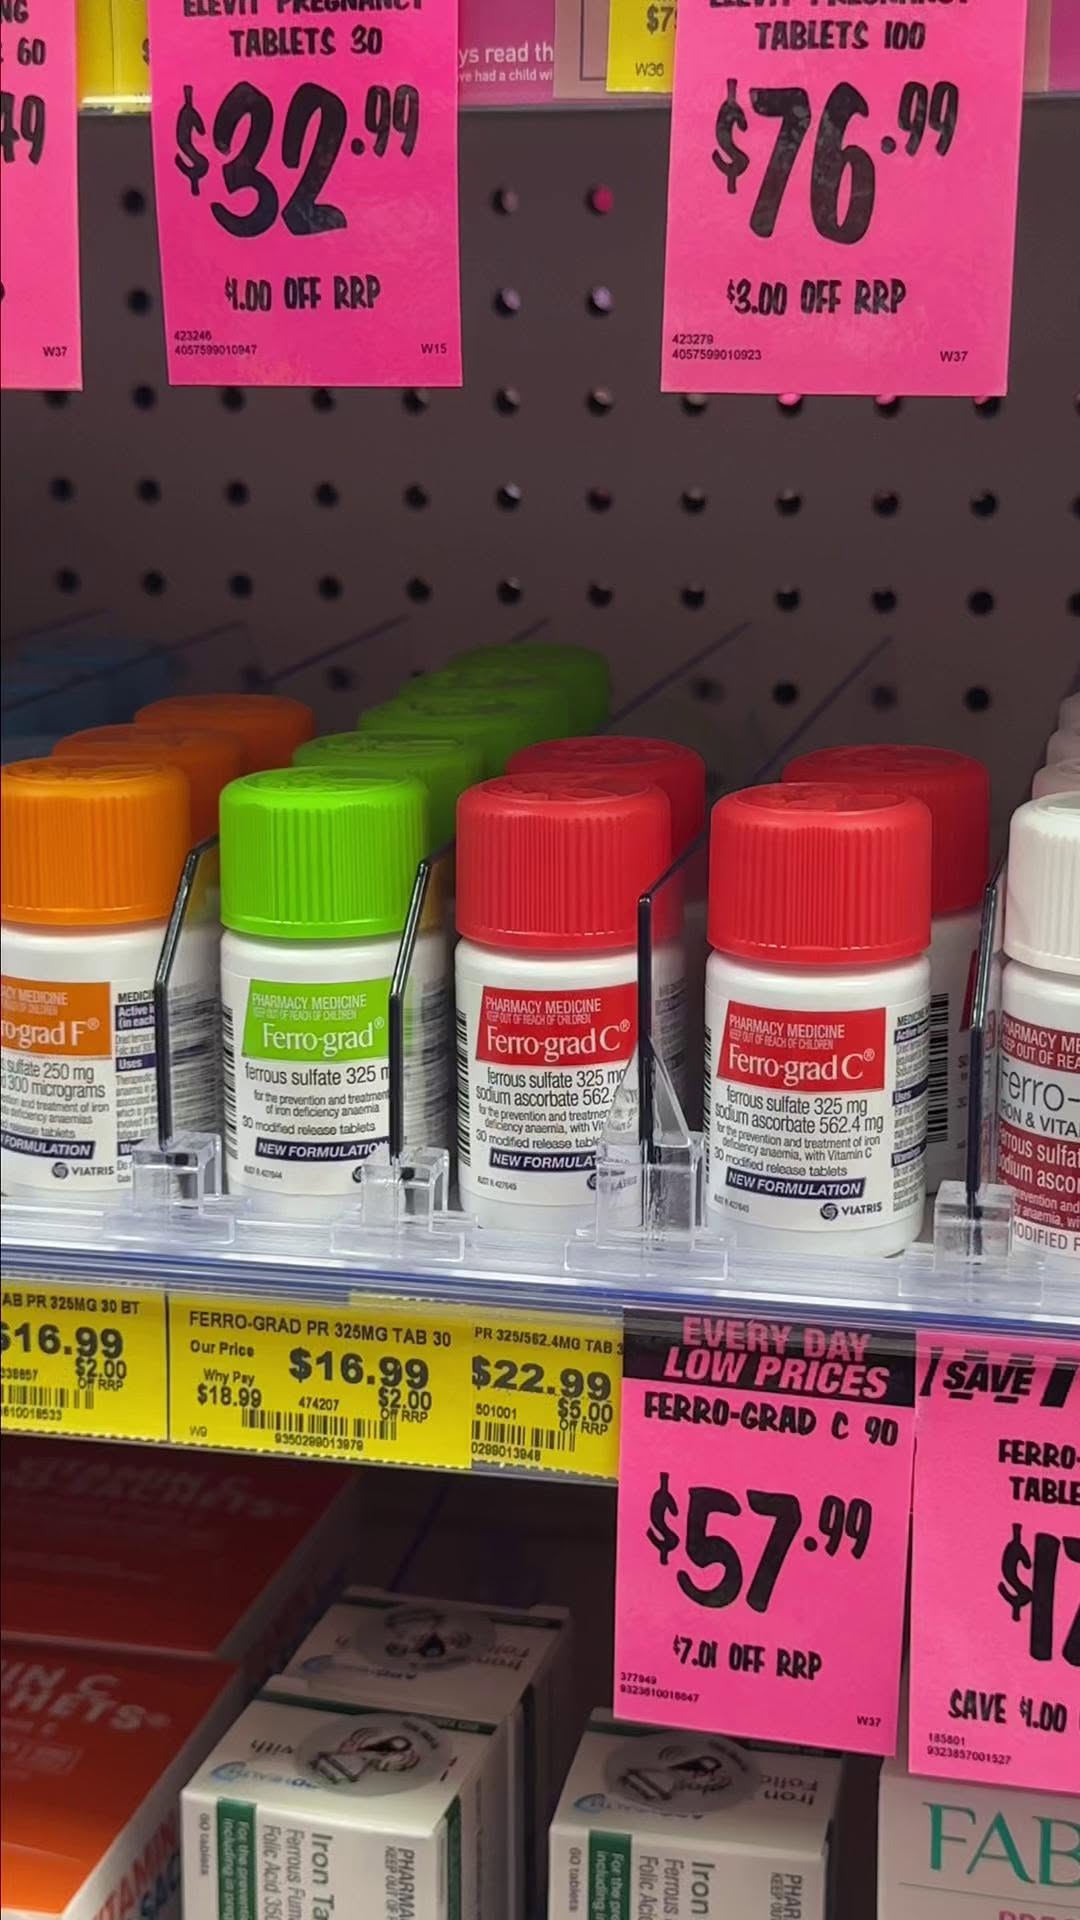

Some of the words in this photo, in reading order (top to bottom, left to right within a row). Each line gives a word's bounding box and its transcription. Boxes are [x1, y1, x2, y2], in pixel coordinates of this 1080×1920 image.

[229, 27, 336, 57] TABLETS
[350, 25, 383, 55] 30
[755, 20, 869, 50] TABLETS
[884, 20, 925, 50] 100
[17, 37, 46, 66] 60
[485, 41, 529, 63] read
[475, 69, 496, 82] had
[499, 73, 506, 81] a
[509, 69, 536, 81] child
[175, 81, 420, 238] $32.99
[712, 77, 960, 245] $76.99
[225, 276, 272, 311] $1.00
[284, 276, 321, 310] OFF
[333, 275, 381, 310] RRP
[726, 279, 787, 316] $3.00
[801, 280, 842, 315] OFF
[854, 279, 906, 315] RRP
[174, 330, 212, 341] 423246
[672, 334, 714, 345] 423279
[43, 346, 68, 357] W37
[421, 344, 447, 355] W15
[672, 348, 762, 361] 4057599010923
[940, 351, 968, 362] W37
[252, 993, 308, 1009] PHARMACY
[312, 993, 368, 1010] MEDICINE
[485, 995, 541, 1013] PHARMACY
[545, 998, 601, 1013] MEDICINE
[730, 1015, 784, 1037] PHARMACY
[787, 1024, 845, 1039] MEDICINE
[487, 1025, 596, 1063] Ferro-grad
[799, 1038, 833, 1050] CHILDREN
[1017, 1042, 1036, 1060] OUT
[1040, 1049, 1054, 1064] OF
[43, 1062, 69, 1080] 250
[73, 1067, 94, 1084] mg
[118, 1058, 143, 1070] Uses
[245, 1062, 288, 1085] ferrous
[291, 1067, 341, 1086] sulfate
[346, 1066, 376, 1085] 325
[729, 1044, 837, 1087] Ferro-grad
[487, 1067, 526, 1088] ferrous
[529, 1069, 573, 1089] sulfate
[576, 1070, 603, 1087] 325
[31, 1079, 106, 1101] micrograms
[280, 1093, 326, 1106] prevention
[328, 1094, 346, 1105] and
[476, 1085, 511, 1106] sodium
[514, 1089, 579, 1107] ascorbate
[726, 1085, 763, 1111] ferrous
[767, 1094, 810, 1115] sulfate
[814, 1098, 842, 1115] 325
[846, 1098, 868, 1117] mg
[36, 1101, 78, 1112] treatment
[81, 1102, 90, 1112] of
[92, 1103, 110, 1112] iron
[275, 1105, 291, 1116] iron
[293, 1105, 339, 1119] deficiency
[341, 1103, 380, 1117] anaemia
[500, 1109, 546, 1123] prevention
[549, 1110, 567, 1121] and
[242, 1115, 254, 1129] 30
[256, 1120, 296, 1135] modified
[298, 1123, 337, 1135] release
[340, 1121, 376, 1135] tablets
[485, 1118, 523, 1134] deficiency
[570, 1123, 590, 1132] with
[715, 1102, 750, 1125] sodium
[752, 1113, 815, 1133] ascorbate
[819, 1116, 861, 1134] 562.4
[864, 1115, 884, 1136] mg
[1026, 1112, 1036, 1128] &
[4, 1135, 91, 1156] FORMULATION
[476, 1129, 487, 1143] 30
[489, 1134, 530, 1149] modified
[532, 1137, 572, 1149] release
[738, 1126, 782, 1147] prevention
[784, 1132, 802, 1146] and
[804, 1135, 850, 1148] treatment
[853, 1134, 862, 1146] of
[864, 1135, 881, 1146] iron
[258, 1142, 286, 1156] NEW
[492, 1152, 521, 1167] NEW
[805, 1151, 826, 1162] with
[829, 1148, 863, 1161] Vitamin
[865, 1147, 872, 1158] C
[71, 1165, 114, 1177] VIATRIS
[726, 1151, 763, 1171] modified
[766, 1163, 806, 1176] release
[809, 1165, 848, 1176] tablets
[728, 1171, 755, 1187] NEW
[757, 1178, 861, 1196] FORMULATION
[842, 1202, 882, 1216] VIATRIS
[3, 1293, 23, 1307] AB
[26, 1294, 47, 1309] PR
[50, 1296, 97, 1312] 325MG
[102, 1300, 117, 1313] 30
[121, 1300, 140, 1314] BT
[190, 1310, 301, 1334] FERRO-GRAD
[307, 1319, 329, 1337] PR
[335, 1321, 388, 1341] 325MG
[395, 1326, 427, 1345] TAB
[433, 1330, 451, 1348] 30
[474, 1326, 492, 1340] PR
[496, 1329, 580, 1350] 325/562.4MG
[585, 1339, 613, 1354] TAB
[682, 1316, 792, 1354] EVERY
[803, 1328, 871, 1362] DAY
[191, 1340, 215, 1353] Our
[219, 1342, 254, 1357] Price
[75, 1357, 127, 1380] $2.00
[204, 1368, 229, 1385] Why
[233, 1371, 255, 1387] Pay
[289, 1346, 429, 1390] $16.99
[472, 1354, 611, 1401] $22.99
[664, 1346, 748, 1384] LOW
[754, 1356, 890, 1399] PRICES
[943, 1361, 1036, 1396] SAVE
[98, 1379, 123, 1391] RRP
[198, 1383, 262, 1408] $18.99
[299, 1396, 340, 1411] 474207
[378, 1386, 432, 1411] $2.00
[401, 1410, 428, 1423] RRP
[475, 1403, 517, 1419] 501001
[558, 1398, 613, 1423] $5.00
[644, 1391, 817, 1435] FERRO-GRAD
[832, 1411, 849, 1439] C
[865, 1416, 899, 1446] 90
[581, 1420, 608, 1436] RRP
[646, 1471, 872, 1612] $57.99
[729, 1642, 765, 1673] OFF
[776, 1648, 822, 1680] RRP
[857, 1715, 881, 1727] W37
[948, 1688, 1007, 1724] SAVE
[1020, 1696, 1068, 1733] $1.00
[263, 1824, 282, 1858] Folic
[286, 1828, 305, 1883] Ferrous
[311, 1832, 334, 1885] Iron
[263, 1859, 281, 1894] Acid
[639, 1855, 659, 1891] Folic
[663, 1857, 684, 1915] Ferrous
[691, 1861, 715, 1915] Iron
